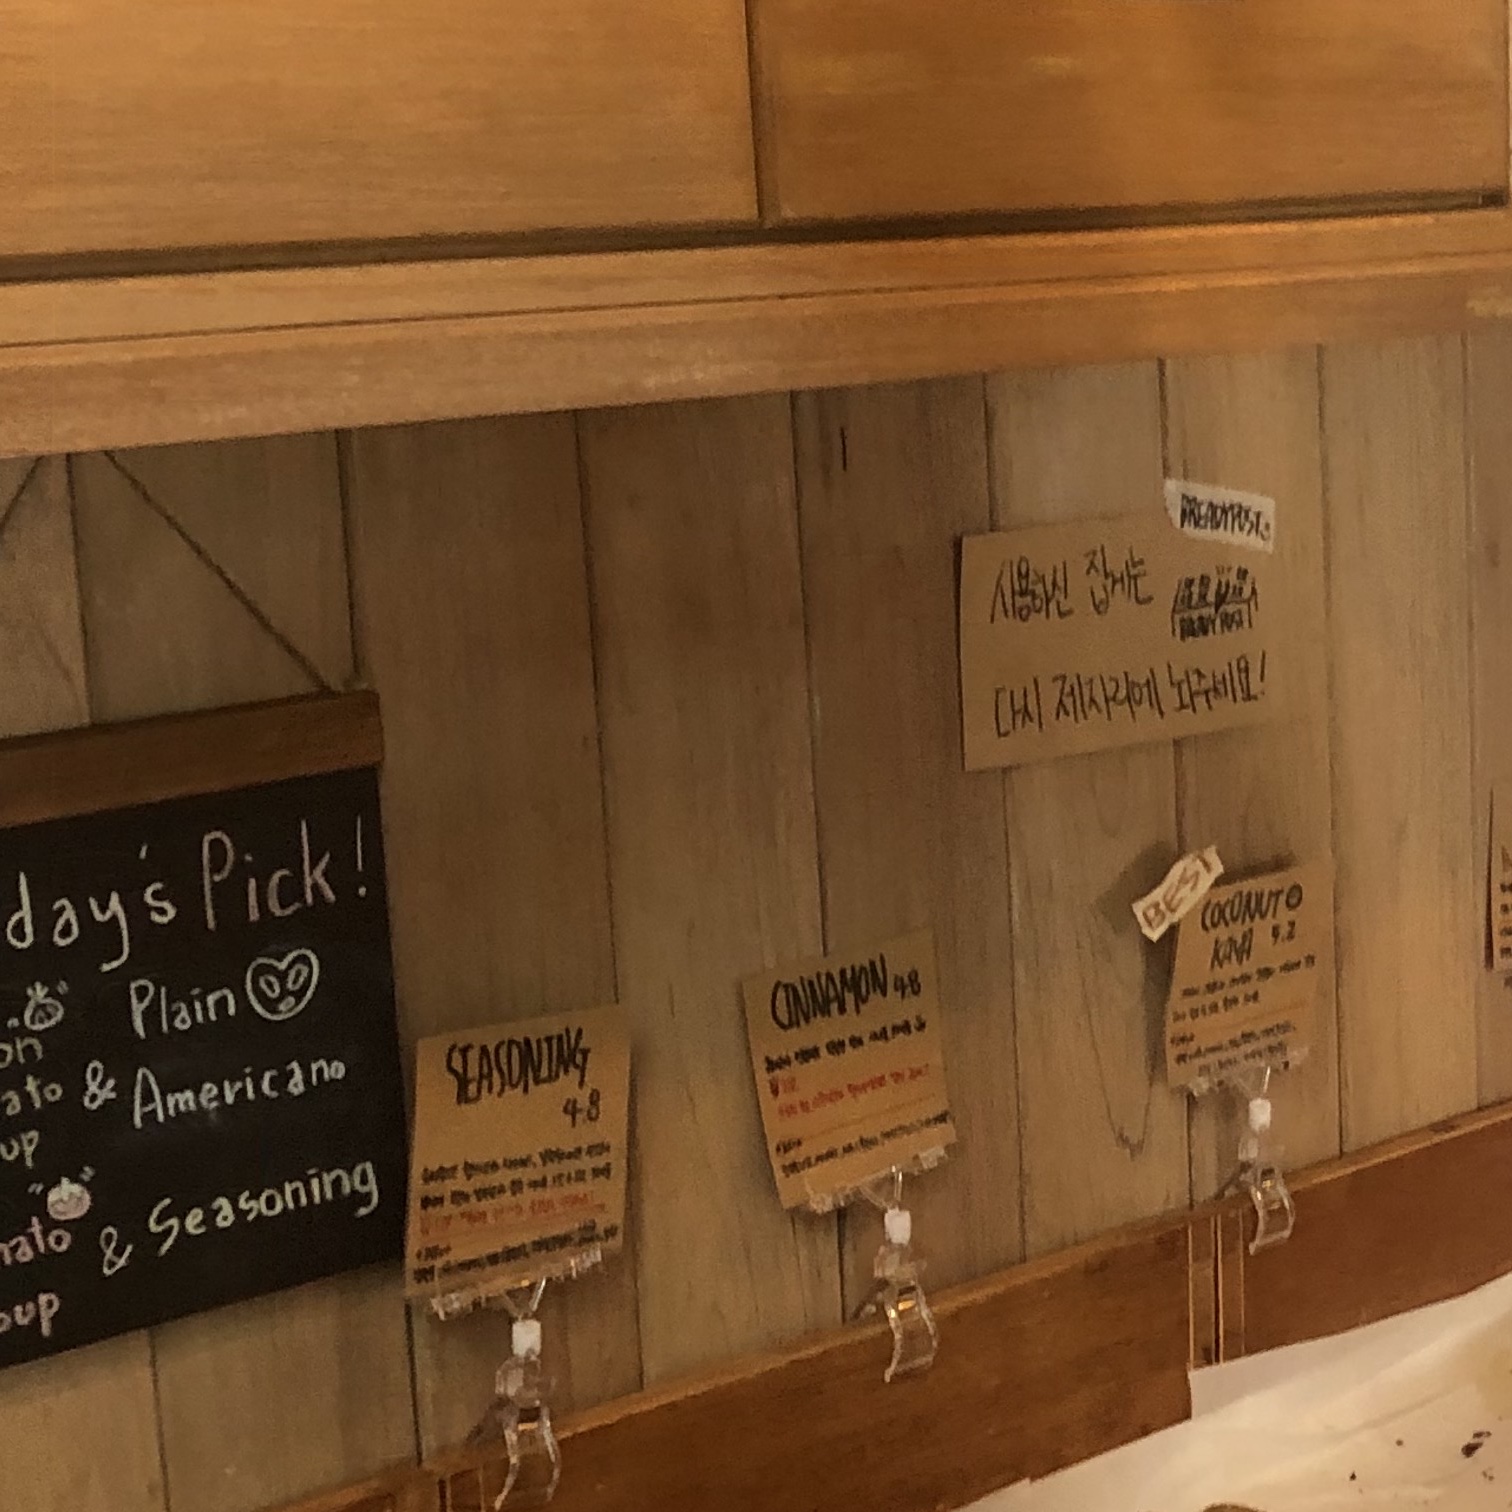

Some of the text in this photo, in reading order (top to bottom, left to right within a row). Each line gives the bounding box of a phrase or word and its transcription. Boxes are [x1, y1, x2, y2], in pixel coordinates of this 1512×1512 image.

[201, 814, 367, 931] Pick!
[129, 978, 236, 1040] Plain
[770, 953, 889, 1030] CINNAMON
[83, 1059, 117, 1111] &
[133, 1058, 346, 1130] Americano
[446, 1026, 591, 1105] SEASONING
[100, 1224, 134, 1277] &
[148, 1160, 379, 1257] Seasoning
